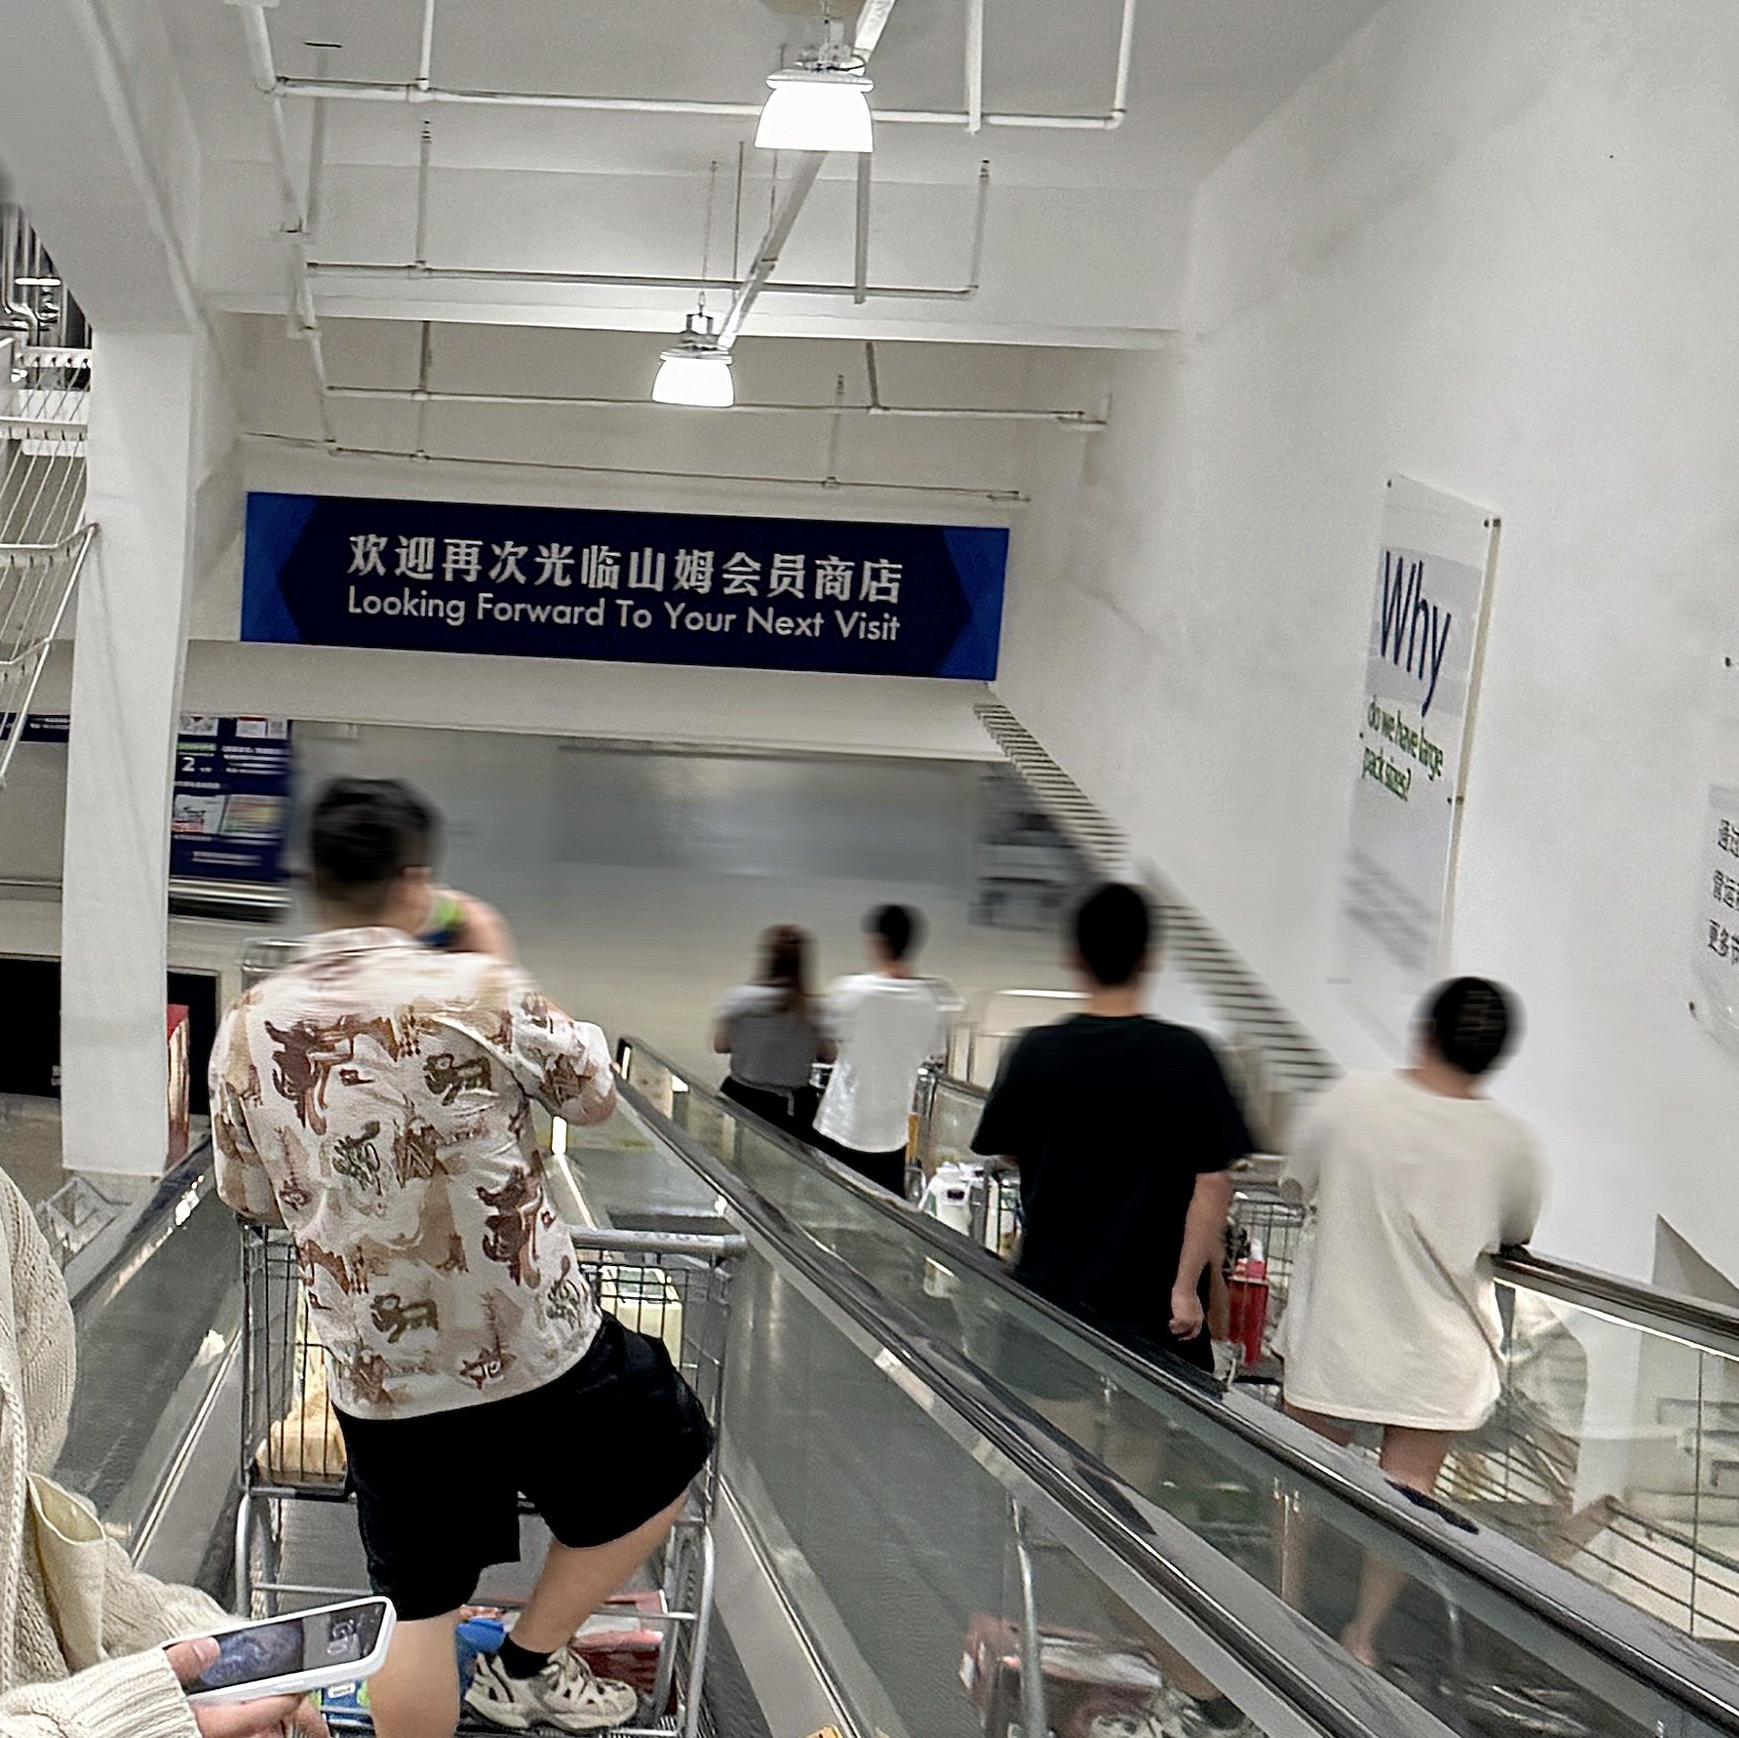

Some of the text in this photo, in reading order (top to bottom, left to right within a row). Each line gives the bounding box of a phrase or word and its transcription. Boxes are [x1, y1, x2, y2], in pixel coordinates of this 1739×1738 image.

[347, 534, 902, 603] 欢迎再次光临山姆会员商店
[348, 585, 901, 641] Looking Forward To Your Next Visit
[1380, 550, 1451, 717] Why
[181, 757, 195, 772] 2
